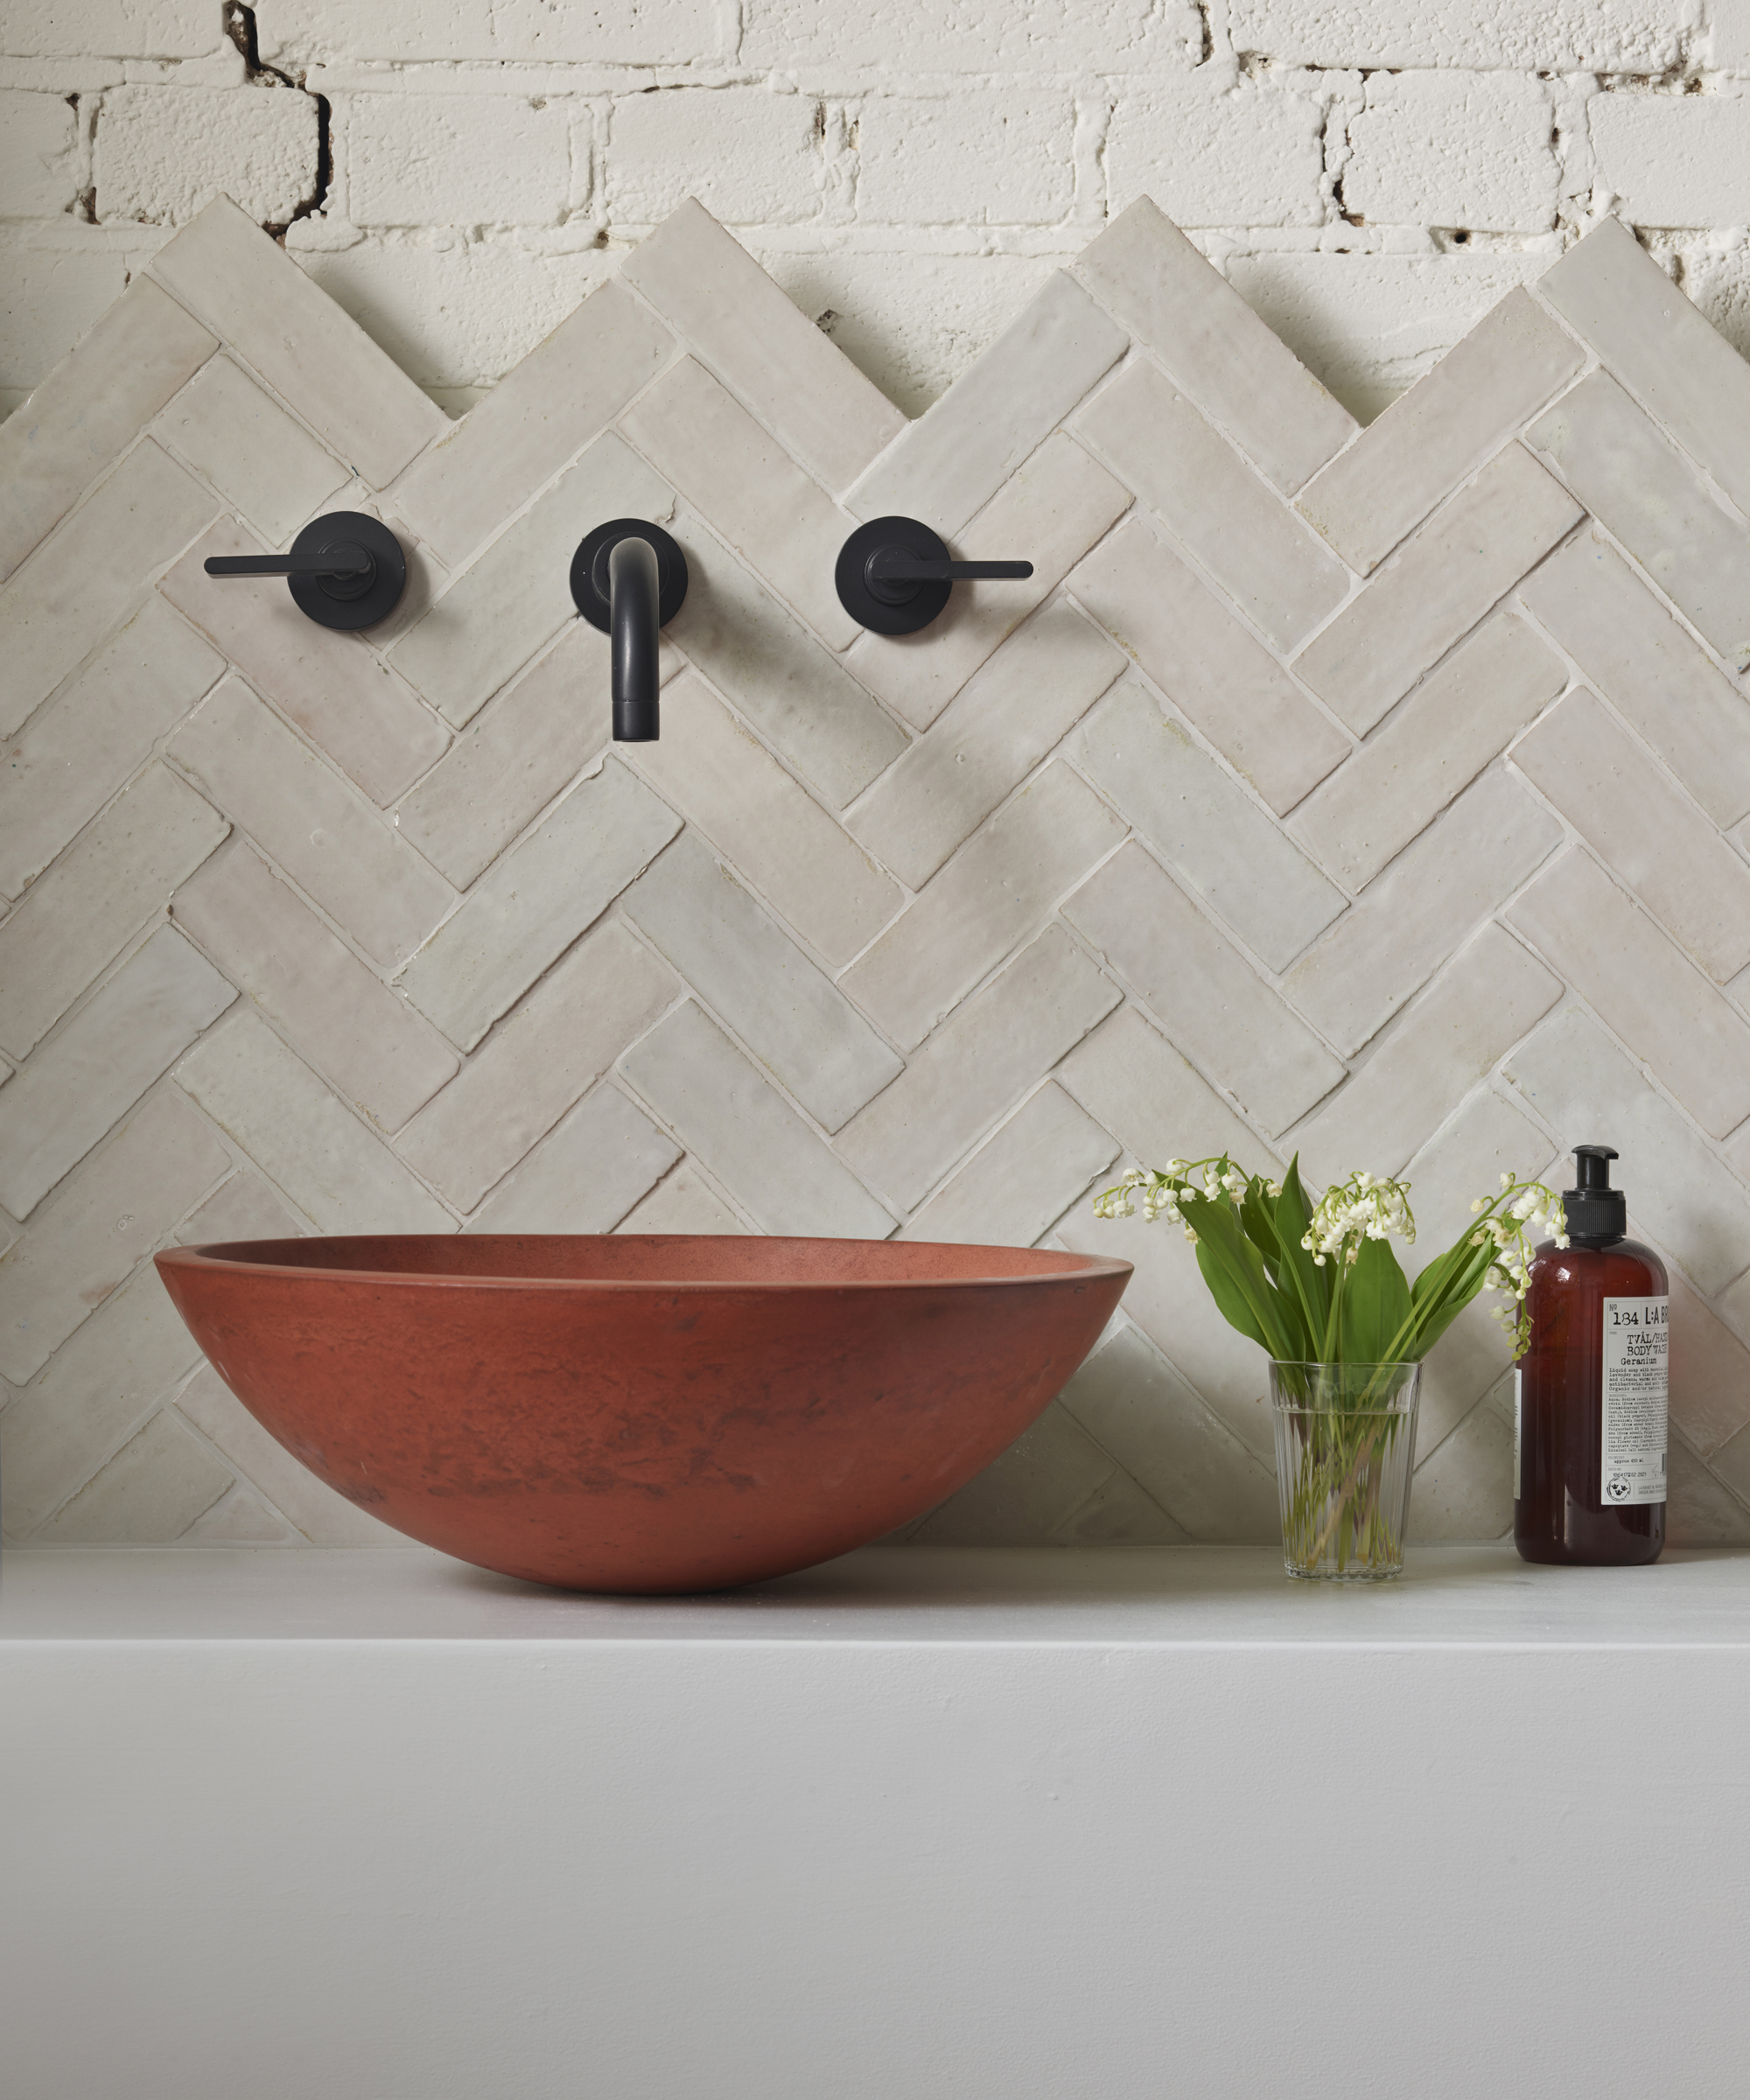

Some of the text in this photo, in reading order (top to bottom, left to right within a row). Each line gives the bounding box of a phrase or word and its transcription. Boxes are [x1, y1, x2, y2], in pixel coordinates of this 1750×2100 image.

[1614, 1312, 1639, 1326] 184
[1646, 1306, 1659, 1325] L:A
[1627, 1343, 1652, 1356] BODY
[1621, 1357, 1656, 1366] Geranium
